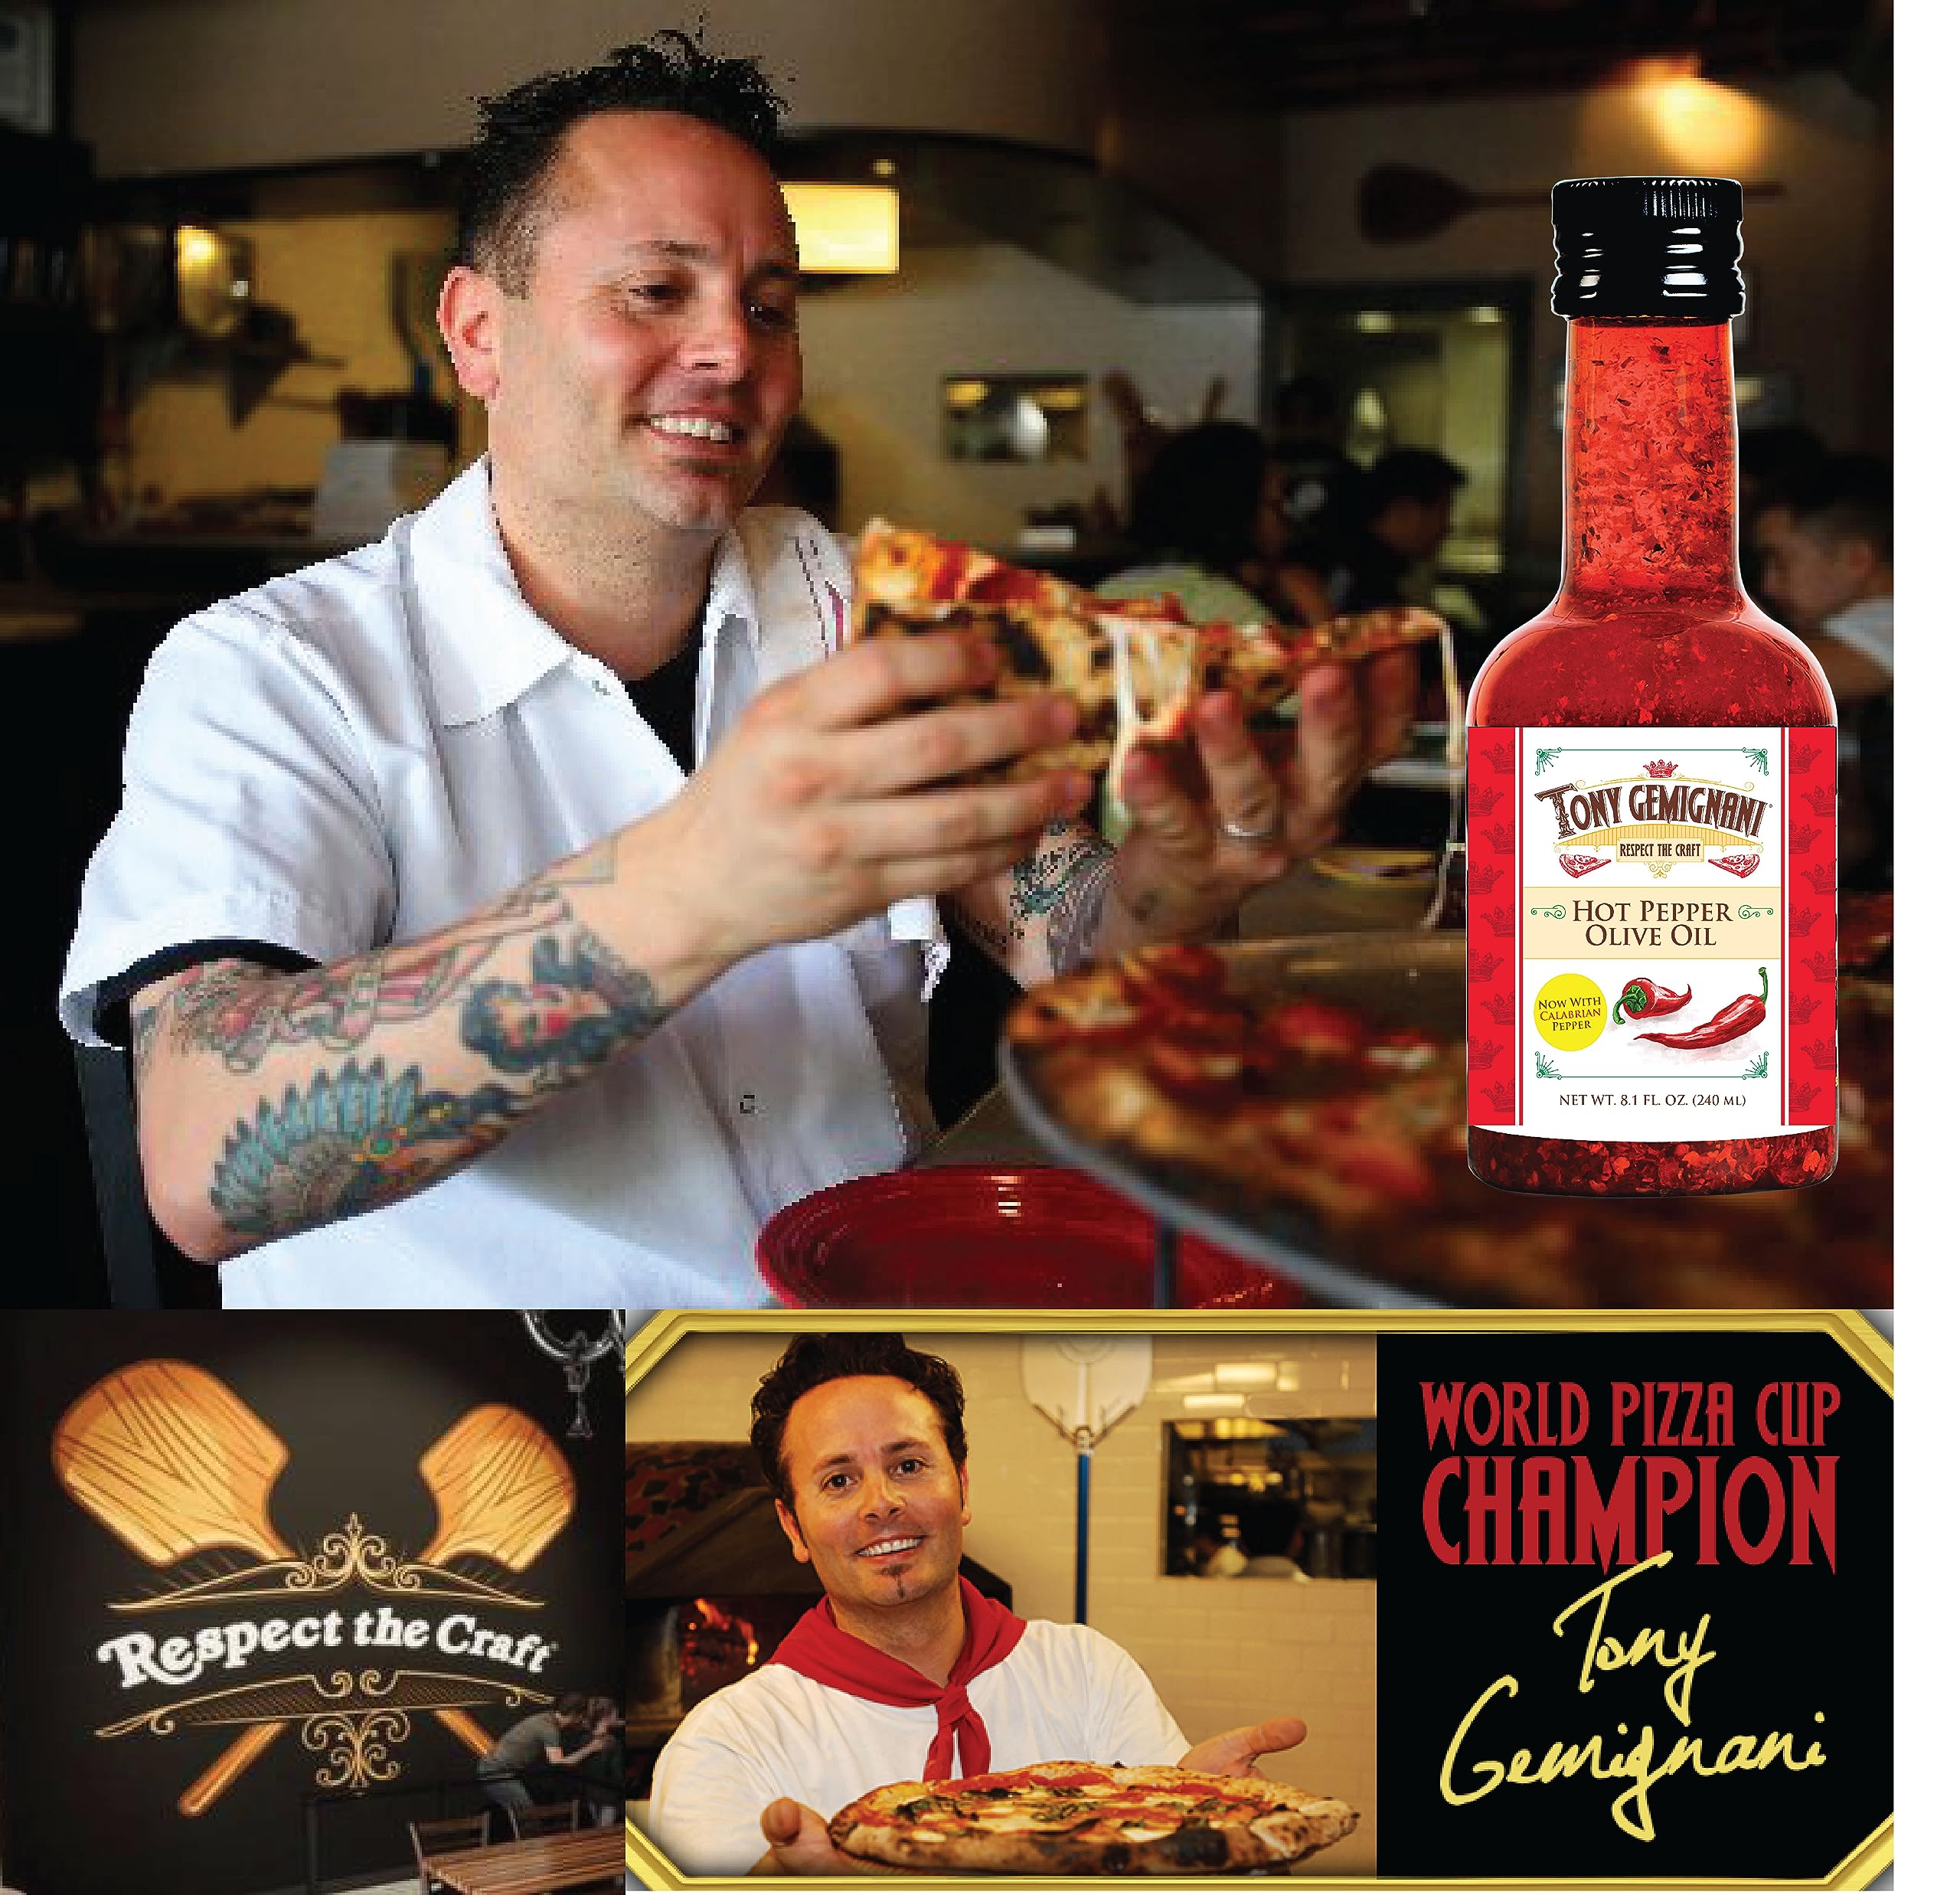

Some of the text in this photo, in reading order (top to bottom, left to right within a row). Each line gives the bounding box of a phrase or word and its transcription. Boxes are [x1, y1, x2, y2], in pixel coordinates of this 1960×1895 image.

[1534, 783, 1768, 839] TONY GEMIGNANI
[1619, 843, 1701, 857] RESPECT THE CRAFT
[1572, 900, 1734, 922] HOT PEPPER
[1585, 923, 1717, 946] OLIVE OIL
[1538, 997, 1601, 1010] NOW WITH
[1540, 1008, 1601, 1021] CALABRIAN
[1552, 1020, 1592, 1031] PEPPER
[1560, 1093, 1746, 1109] NET WT. 8.1 FL. OZ. (240 ML)
[1419, 1382, 1841, 1451] WORLD PIZZA CUP
[1423, 1456, 1841, 1575] CHAMPION
[96, 1608, 553, 1688] Respect the Craft
[1552, 1550, 1716, 1727] Tony
[1439, 1674, 1827, 1843] Gemignani
